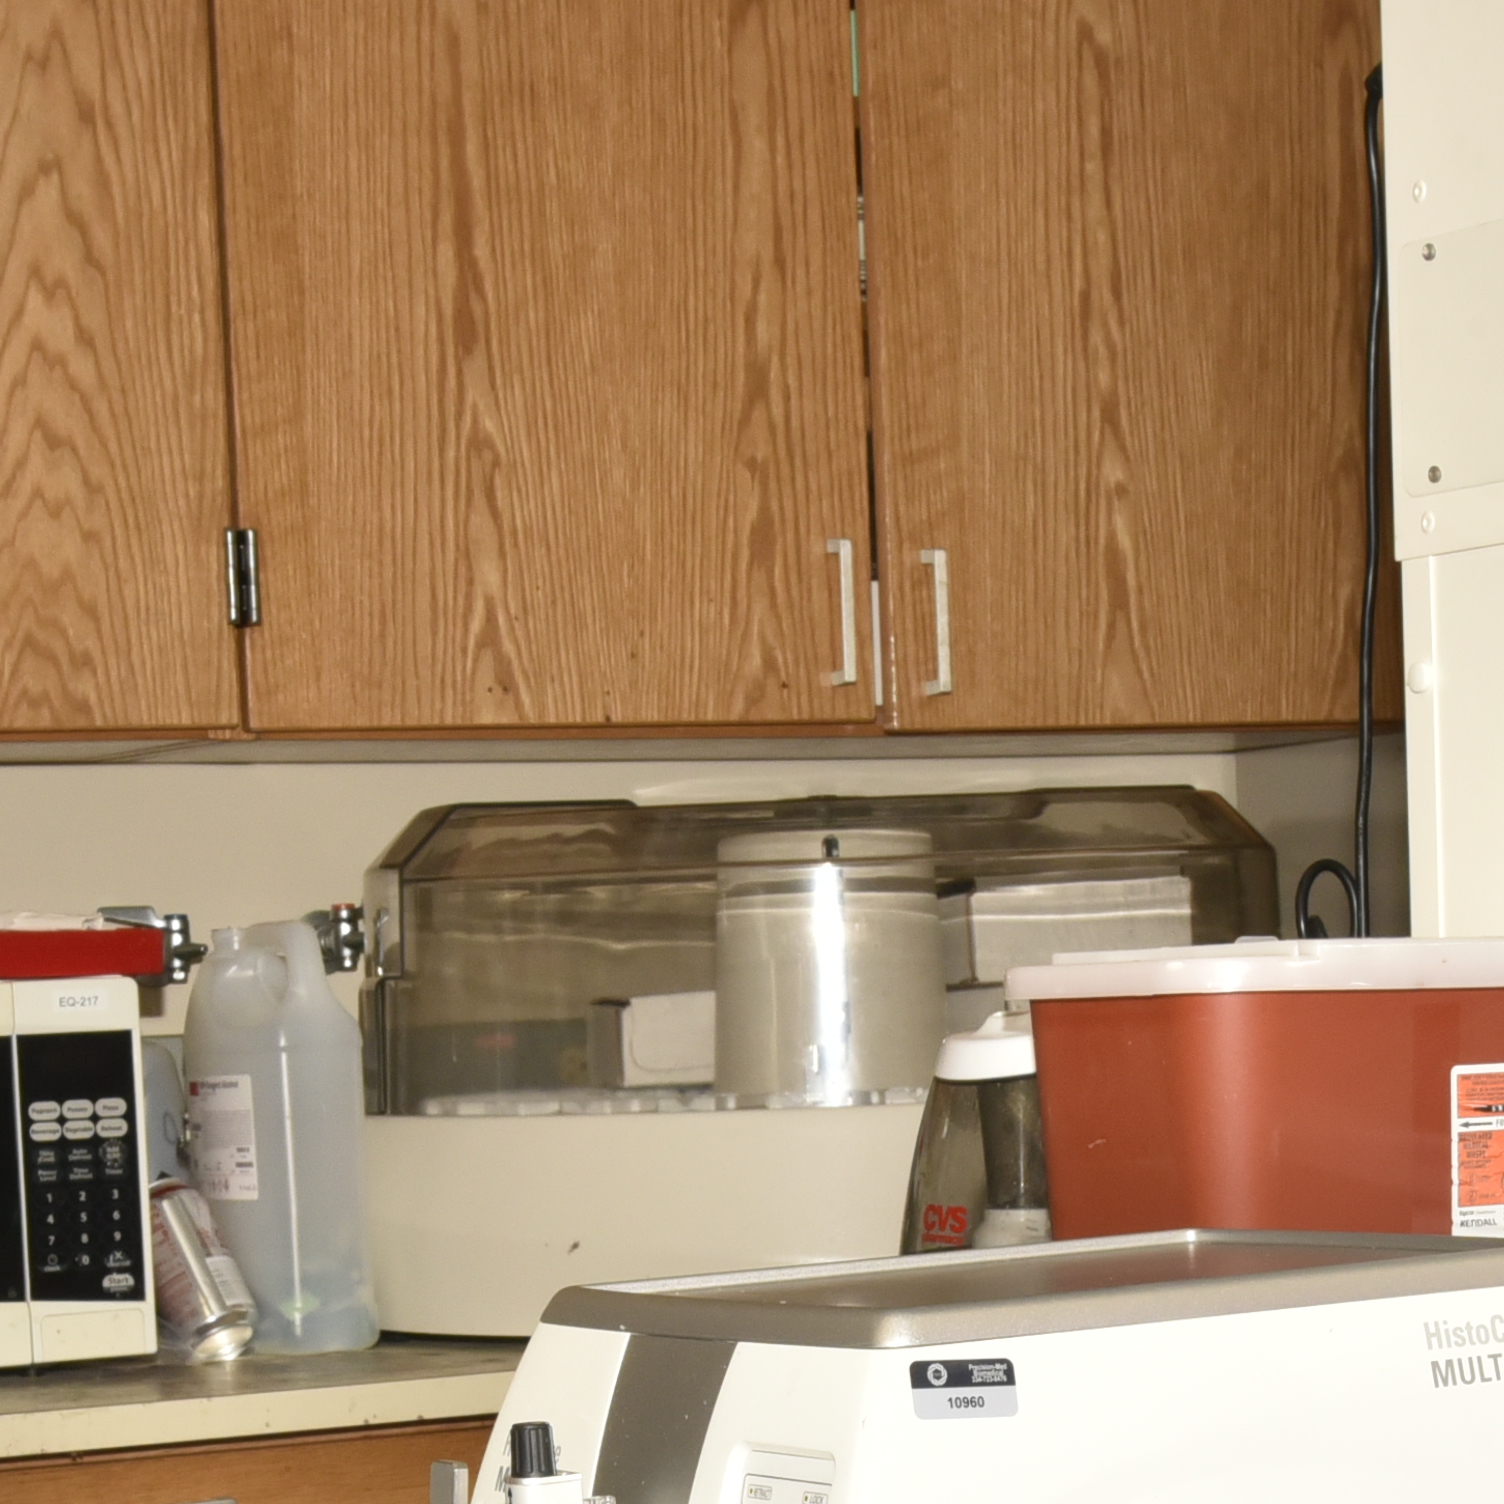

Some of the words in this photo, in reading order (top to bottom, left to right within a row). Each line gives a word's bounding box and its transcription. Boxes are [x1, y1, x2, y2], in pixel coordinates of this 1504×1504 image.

[59, 996, 99, 1007] EQ-217
[46, 1193, 52, 1203] 1
[79, 1190, 86, 1201] 2
[112, 1188, 119, 1199] 3
[47, 1214, 54, 1224] 4
[80, 1211, 87, 1222] 5
[113, 1210, 120, 1220] 6
[923, 1203, 968, 1233] CVS
[48, 1235, 55, 1245] 7
[81, 1233, 88, 1243] 8
[114, 1231, 121, 1241] 9
[82, 1254, 90, 1265] 0
[108, 1276, 129, 1285] Start
[947, 1396, 985, 1409] 10960
[809, 1495, 824, 1504] LOCK
